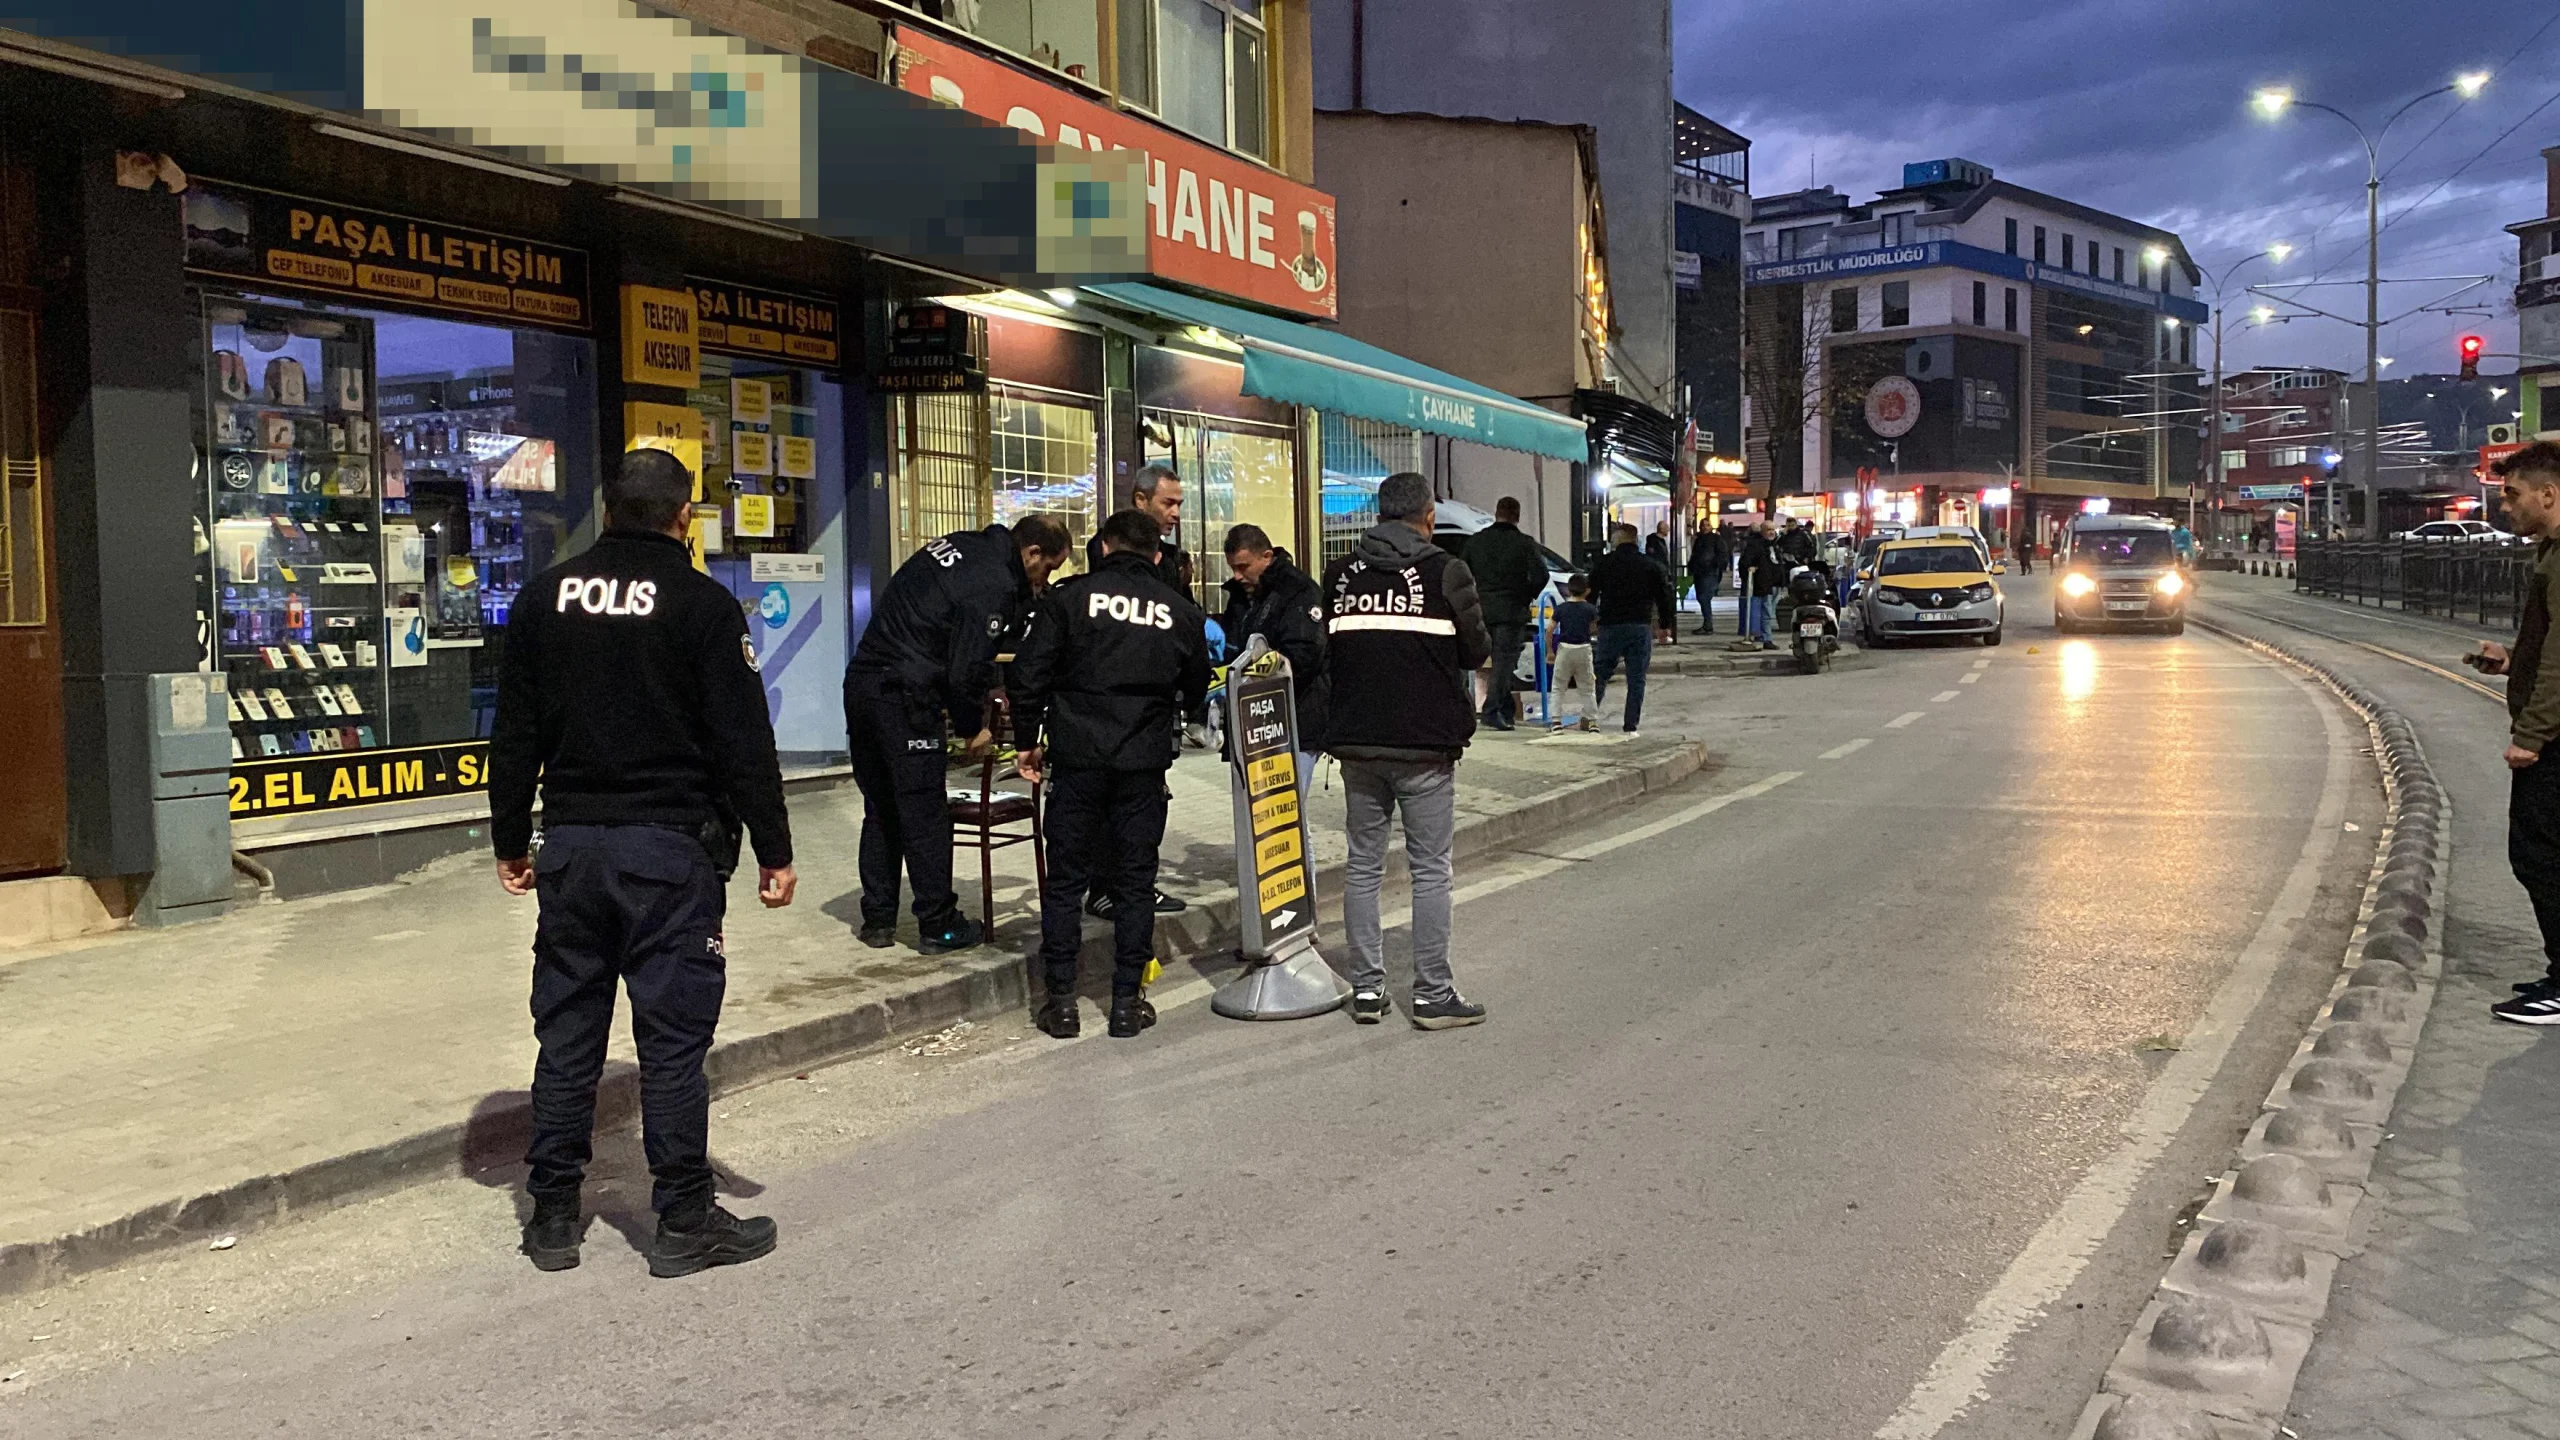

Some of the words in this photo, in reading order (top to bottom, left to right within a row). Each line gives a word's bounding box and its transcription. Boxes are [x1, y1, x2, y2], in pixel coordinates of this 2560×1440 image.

[289, 208, 396, 258] PAŞA
[407, 223, 562, 285] İLETİŞİM
[272, 257, 292, 273] CEP
[294, 261, 350, 282] TELEFONU
[1756, 258, 1834, 281] SERBESTLİK
[1838, 248, 1924, 270] MÜDÜRLÜĞÜ
[370, 271, 422, 292] AKSESUAR
[440, 283, 475, 301] TEKNİK
[476, 287, 509, 307] SERVİS
[515, 296, 548, 314] FATURA
[642, 301, 689, 334] TELEFON
[698, 289, 730, 317] ŞA
[737, 290, 833, 333] İLETİŞİM
[643, 340, 692, 373] AKSESUR
[910, 371, 965, 391] İLETİŞİM
[478, 387, 514, 401] iPhone
[1421, 395, 1476, 428] ÇAYHANE
[926, 536, 963, 568] OLİS
[1333, 572, 1350, 614] OLAY
[1399, 566, 1425, 615] ELEME
[1249, 698, 1275, 719] PAŞA
[1246, 720, 1284, 745] İLETİŞİM
[230, 771, 315, 812] 2.EL
[328, 759, 425, 802] ALIM
[1268, 770, 1291, 787] SERVİS
[1276, 800, 1297, 815] TABLET
[1264, 840, 1291, 861] AKSESUAR
[1276, 875, 1302, 894] TELEFON
[706, 936, 721, 955] PO
